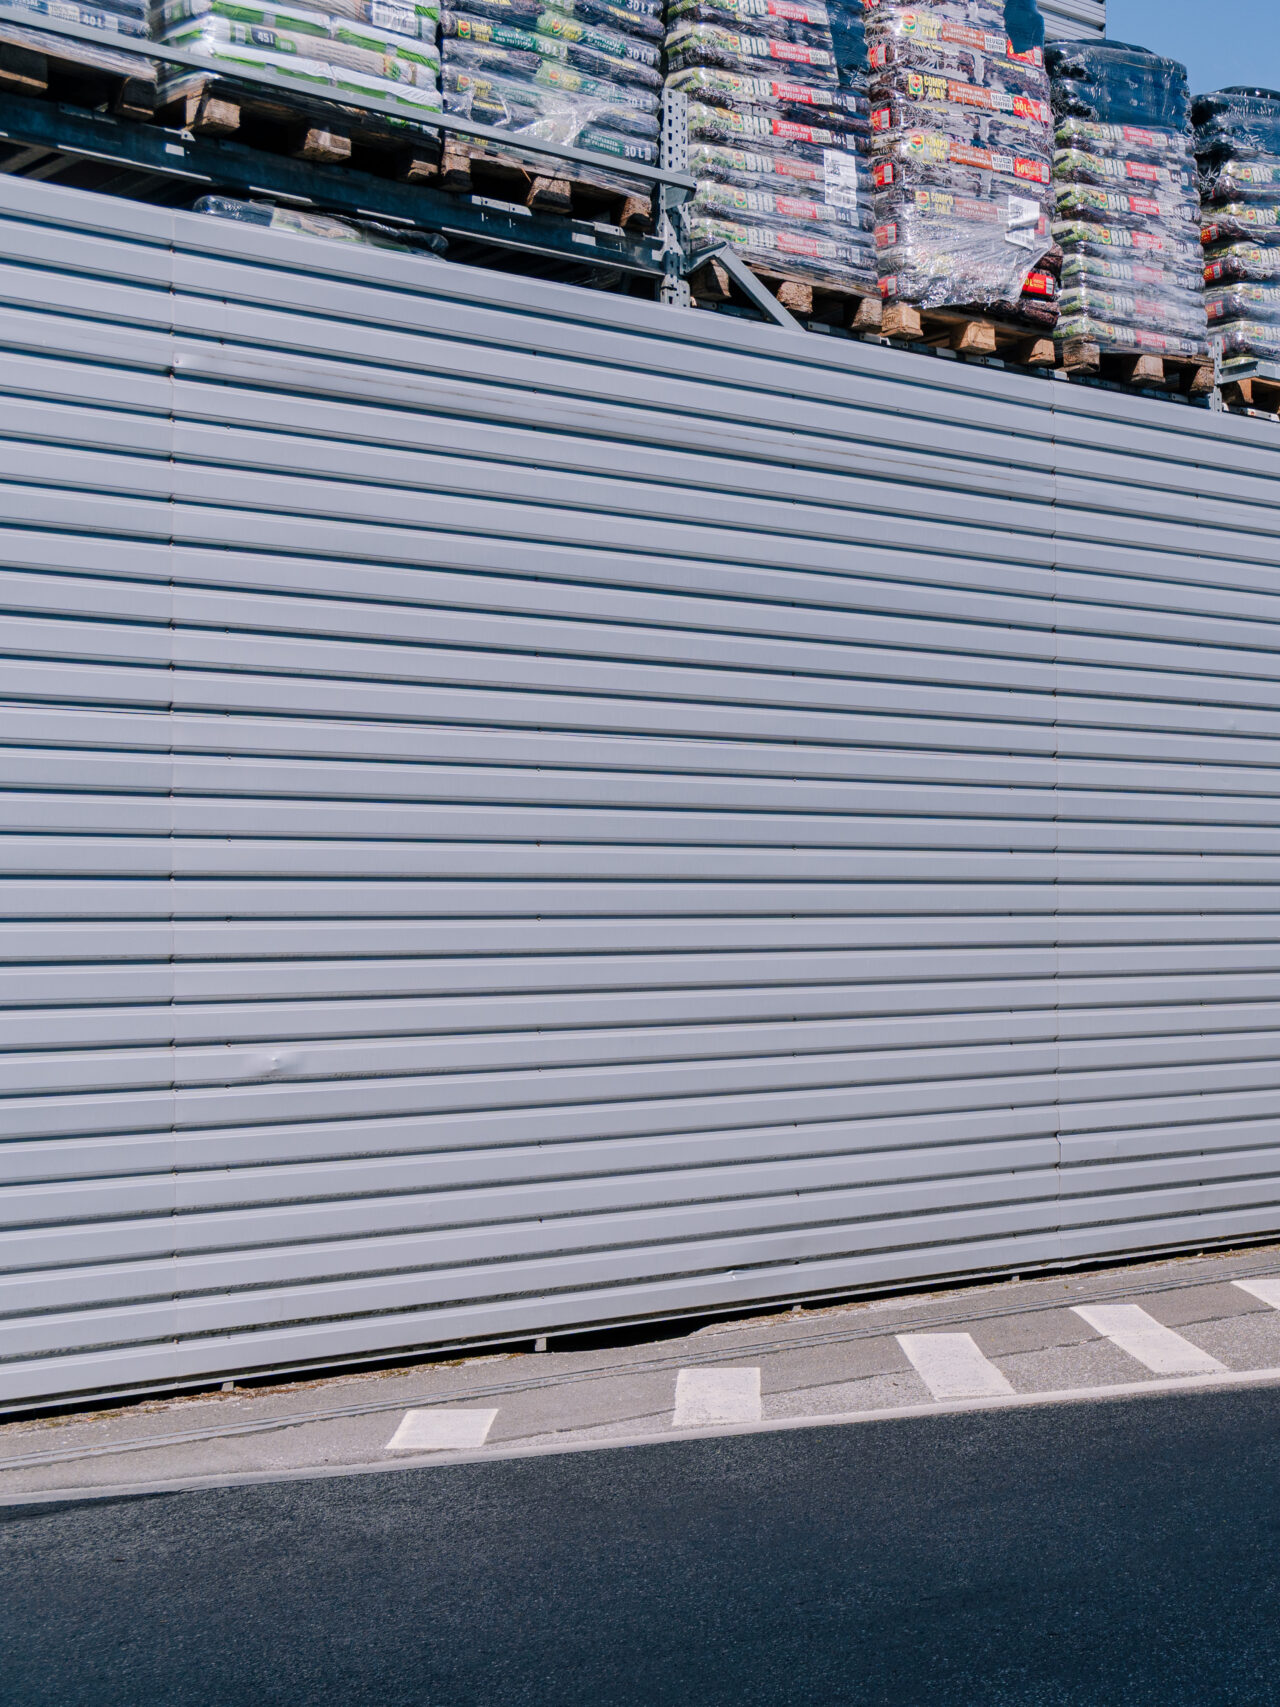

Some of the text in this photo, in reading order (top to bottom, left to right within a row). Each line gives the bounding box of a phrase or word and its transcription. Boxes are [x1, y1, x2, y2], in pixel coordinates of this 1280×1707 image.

[740, 36, 767, 57] BIO
[742, 77, 770, 96] BIO
[743, 115, 770, 136] BIO
[1105, 159, 1126, 177] BIO
[1107, 194, 1129, 212] BIO
[1110, 229, 1132, 247] BIO
